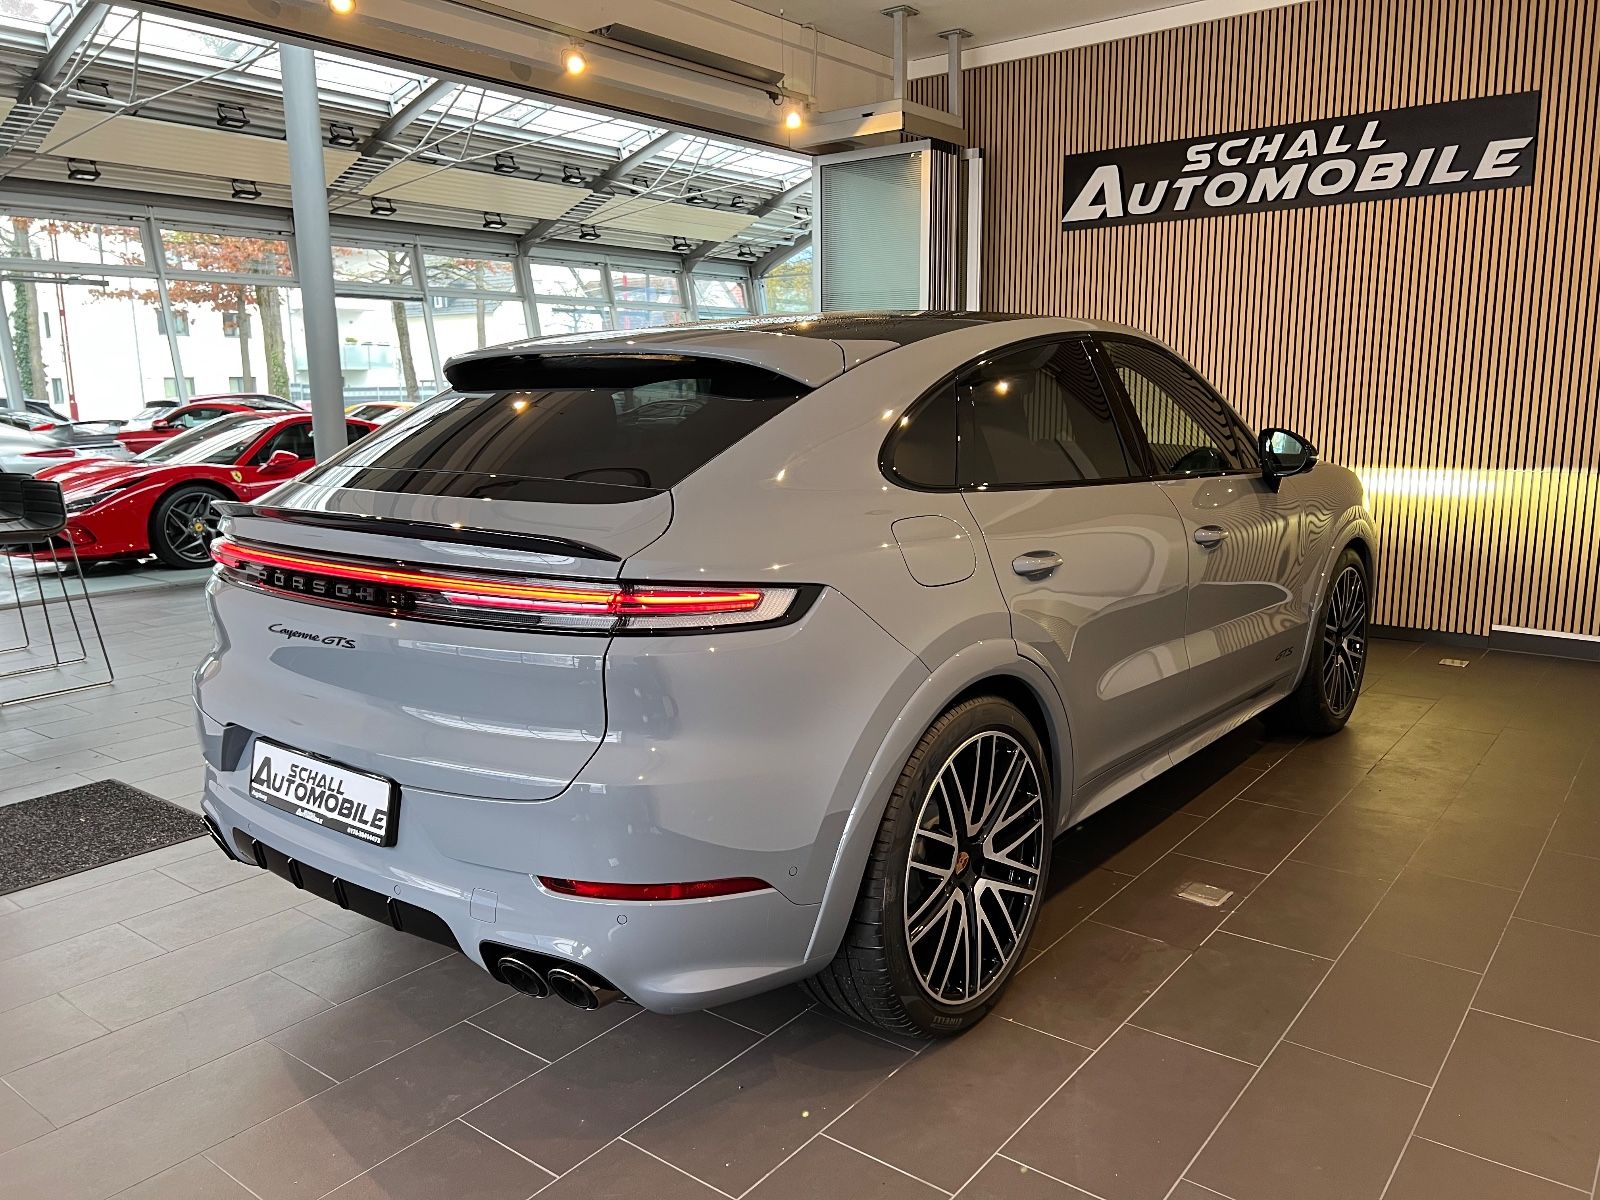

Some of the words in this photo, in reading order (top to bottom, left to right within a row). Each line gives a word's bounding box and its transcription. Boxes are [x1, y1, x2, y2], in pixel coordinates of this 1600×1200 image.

[1182, 120, 1389, 173] SCHALL
[1061, 136, 1534, 223] AUTOMOBILE
[268, 623, 320, 640] Cayenne
[320, 635, 356, 649] GTS
[252, 756, 387, 830] AUTOMOBILE
[288, 763, 345, 795] SCHALL
